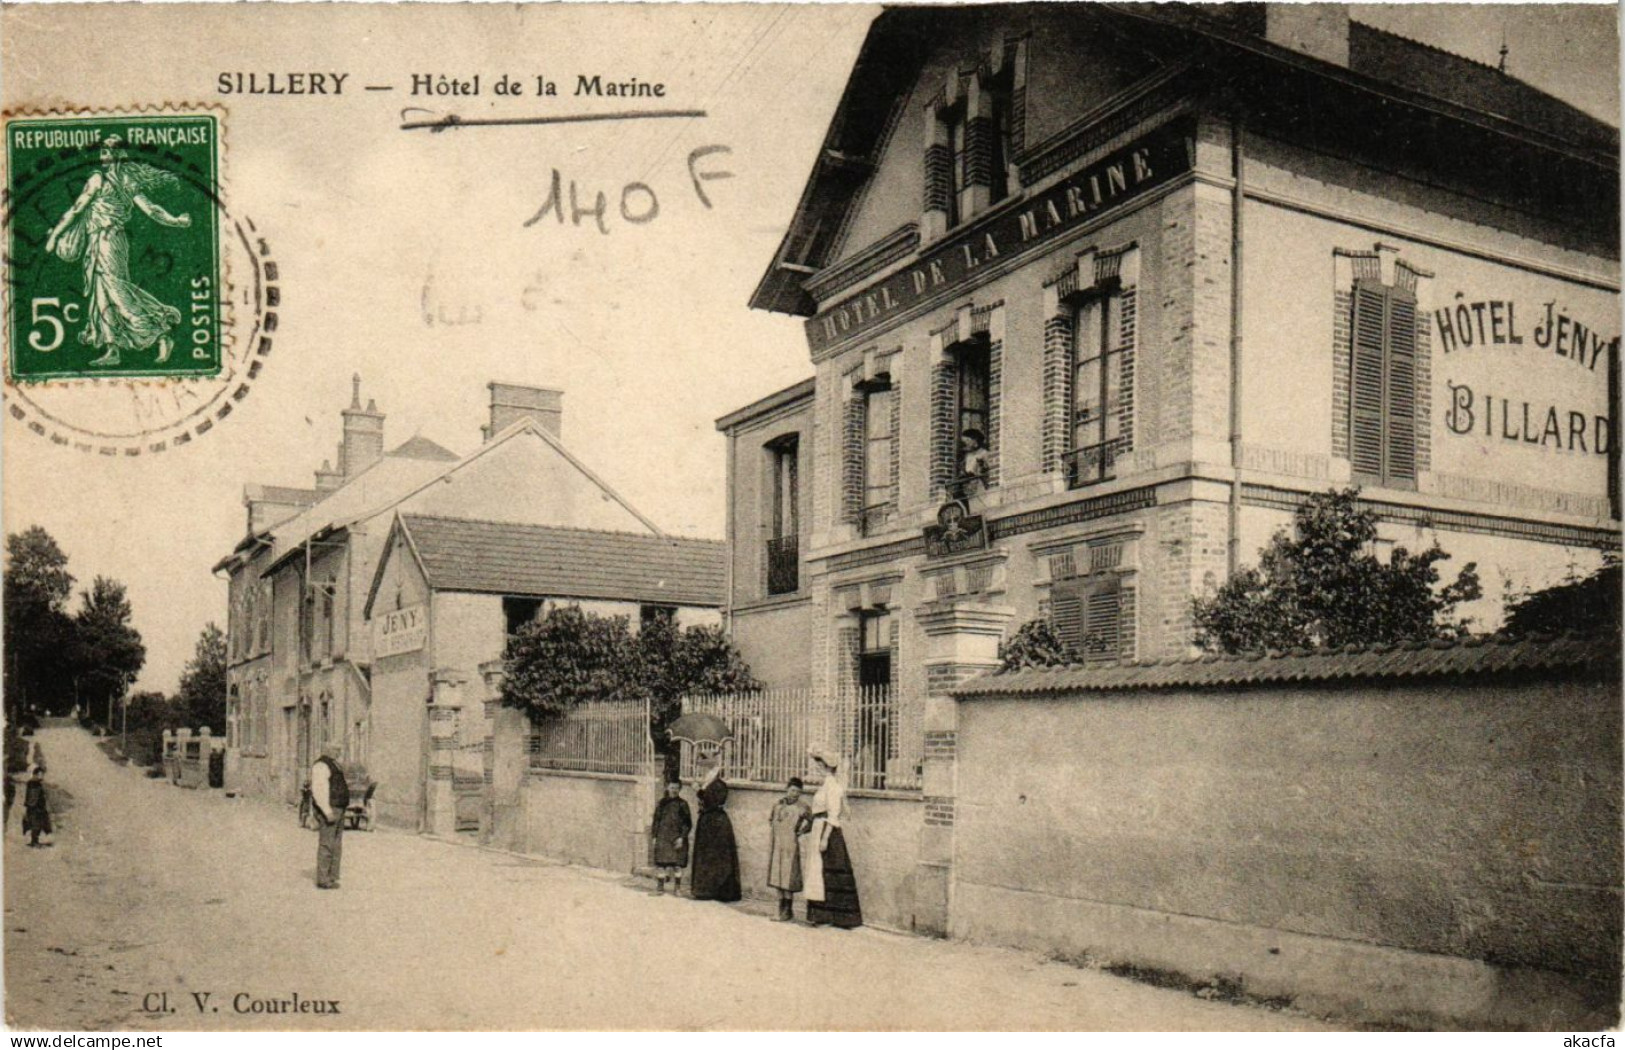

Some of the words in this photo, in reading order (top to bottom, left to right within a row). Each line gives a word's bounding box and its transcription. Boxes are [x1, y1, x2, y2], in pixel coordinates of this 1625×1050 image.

[217, 73, 350, 95] SILLERY
[411, 72, 480, 96] Hôtel
[493, 74, 524, 96] de
[535, 74, 558, 96] la
[573, 74, 667, 98] Marine
[127, 126, 208, 146] FRANÇAISE
[523, 168, 660, 235] 140
[687, 144, 736, 209] F
[912, 259, 947, 295] DE
[963, 233, 999, 269] LA
[1018, 148, 1154, 242] MARINE
[190, 274, 212, 361] POSTES
[1435, 291, 1524, 353] HÔTEL
[1446, 379, 1610, 455] BILLARD
[142, 992, 176, 1014] Cl.
[192, 992, 219, 1013] V.
[233, 992, 341, 1014] Courleux
